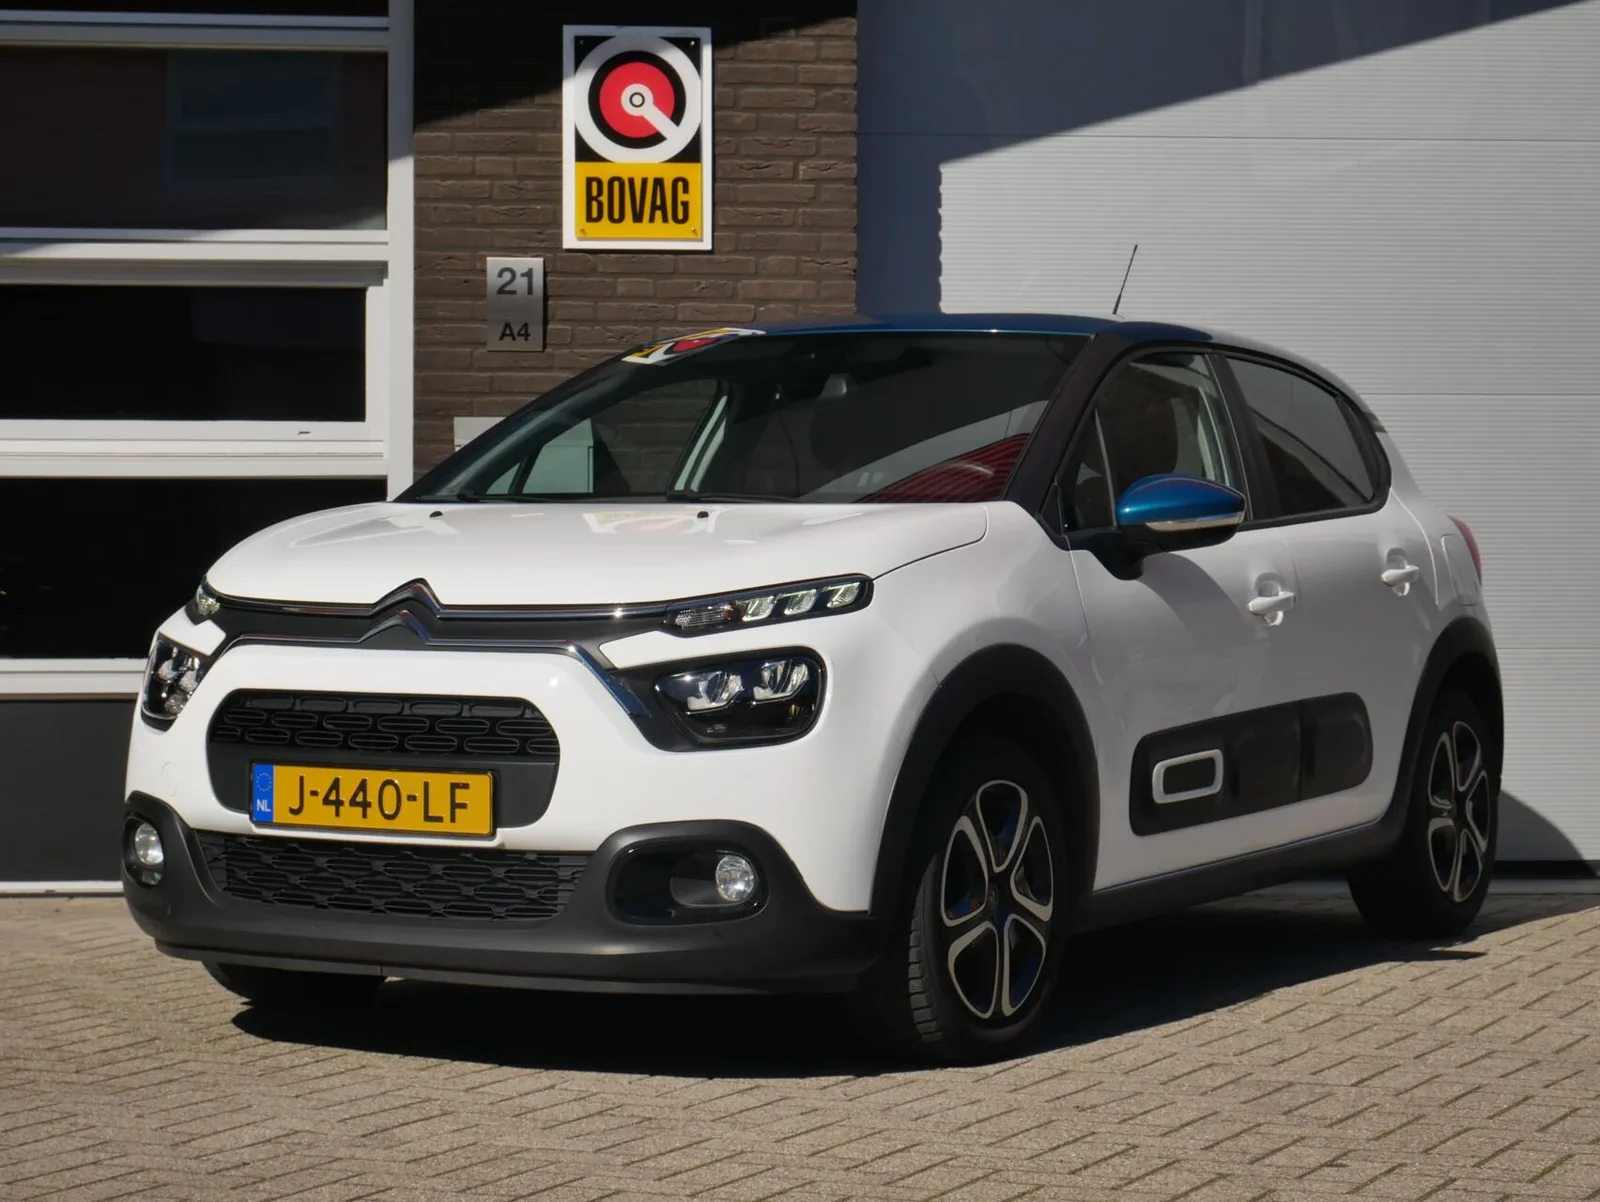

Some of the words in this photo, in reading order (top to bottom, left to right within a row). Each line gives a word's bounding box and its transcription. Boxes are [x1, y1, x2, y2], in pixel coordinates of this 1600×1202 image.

[585, 176, 690, 224] BOVAG
[496, 267, 535, 296] 21
[499, 322, 531, 342] A4
[256, 799, 272, 813] NL
[289, 775, 470, 823] J-440-LF
